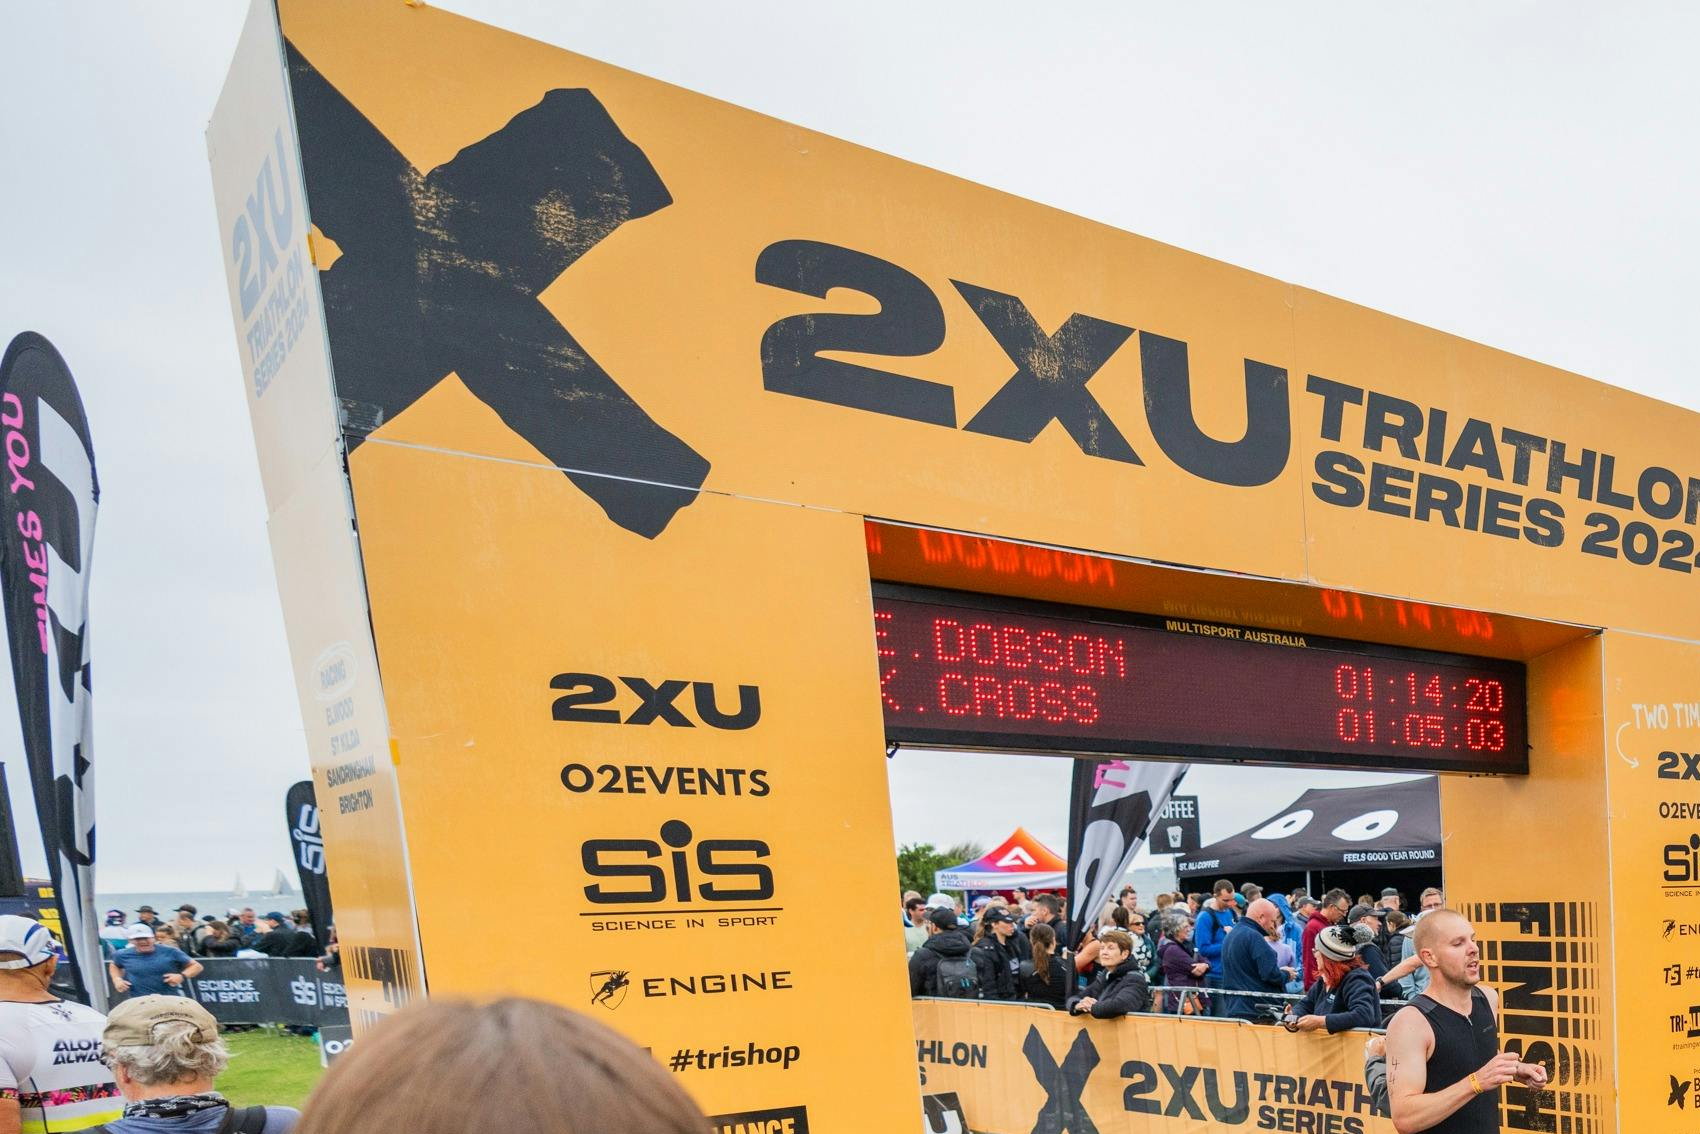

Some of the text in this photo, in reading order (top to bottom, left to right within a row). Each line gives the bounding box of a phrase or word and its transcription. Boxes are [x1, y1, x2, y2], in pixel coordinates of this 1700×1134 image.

[233, 126, 293, 322] 2XU
[755, 239, 1290, 487] 2XU
[1, 391, 35, 494] YOU
[1311, 450, 1565, 547] SERIES
[934, 617, 1127, 679] DOBSON
[1165, 619, 1307, 648] MULTISPORT AUSTRALIA
[549, 672, 762, 731] 2XU
[939, 672, 1100, 726] CROSS
[1334, 663, 1503, 713] 01:14:20
[1337, 707, 1506, 752] 01:05:03
[1631, 703, 1670, 730] TWO
[560, 763, 771, 797] O2EVENTS
[338, 788, 374, 815] BRIGHTON
[1160, 800, 1196, 819] OFFEE
[580, 819, 775, 904] SiS
[1197, 859, 1220, 870] COFFEE
[1343, 849, 1435, 863] FEELS GOOD YEAR ROUND
[591, 916, 778, 932] SCIENCE IN SPORT
[196, 979, 256, 991] SCIENCE
[201, 991, 261, 1003] IN SPORT
[322, 982, 347, 995] SCIEN
[642, 970, 793, 998] ENGINE
[324, 995, 334, 1007] IN
[1500, 902, 1558, 1134] FINISH
[668, 1042, 801, 1073] #trishop
[916, 1039, 987, 1069] HLON
[1119, 1060, 1249, 1126] 2XU
[1253, 1073, 1379, 1117] TRIATH
